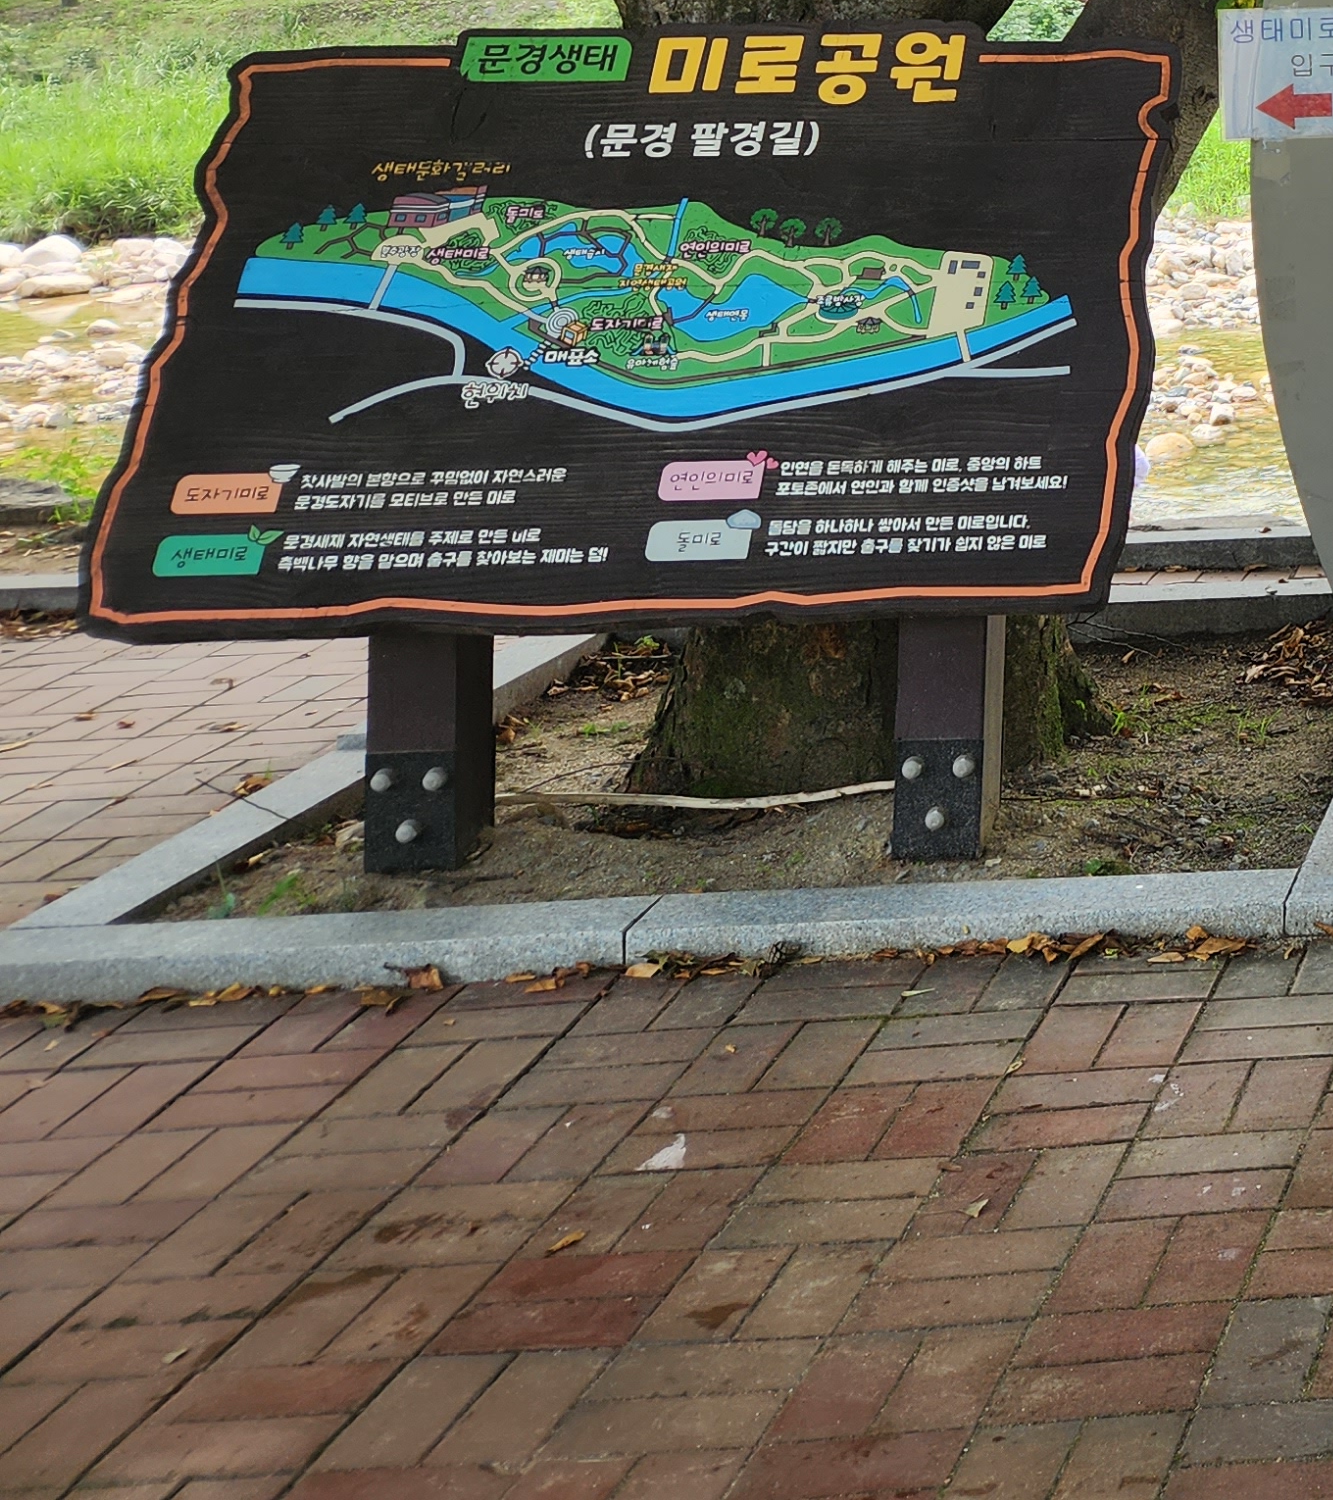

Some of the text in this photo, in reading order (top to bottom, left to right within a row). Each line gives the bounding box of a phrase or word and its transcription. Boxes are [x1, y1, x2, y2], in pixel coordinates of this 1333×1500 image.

[478, 32, 967, 105] 문경생태 미로공원
[584, 120, 821, 159] (문경 팔경길)
[506, 205, 545, 223] 돌미로
[427, 247, 490, 265] 생태미로
[680, 240, 751, 259] 연인의미로
[591, 316, 663, 331] 도자기미로
[706, 309, 749, 322] 생태연못
[544, 349, 599, 366] 매표소
[461, 382, 529, 409] 현위치
[780, 460, 823, 476] 인연을
[826, 459, 883, 475] 돈독하게
[886, 458, 928, 474] 해주는
[966, 456, 1010, 472] 중앙의
[1013, 455, 1042, 471] 하트
[301, 468, 567, 490] 찻사발의 본향으로 꾸밈없이 자연스러운
[670, 470, 754, 491] 연인의미로
[775, 474, 1068, 496] 포토존에서 연인과 함께 인증샷을 남겨보세요!
[185, 486, 270, 502] 도자기미로
[294, 489, 516, 510] 문경도자기를 모티브로 만든 미로
[768, 514, 1031, 536] 돌담을 하나하나 쌓아서 만든 미로입니다.
[283, 533, 345, 550] 문경새재
[347, 530, 425, 548] 자연생태를
[428, 529, 474, 546] 주제로
[478, 528, 508, 544] 만든
[676, 530, 722, 553] 돌미로
[764, 540, 809, 557] 구간이
[812, 539, 857, 556] 짧지만
[907, 536, 952, 553] 찾기가
[954, 535, 983, 552] 쉽지
[986, 534, 1016, 551] 않은
[1018, 533, 1047, 550] 미로
[171, 547, 248, 569] 생태미로
[343, 554, 374, 571] 향을
[476, 549, 537, 566] 찾아보는
[540, 547, 585, 564] 재미는
[588, 546, 609, 563] 덤!
